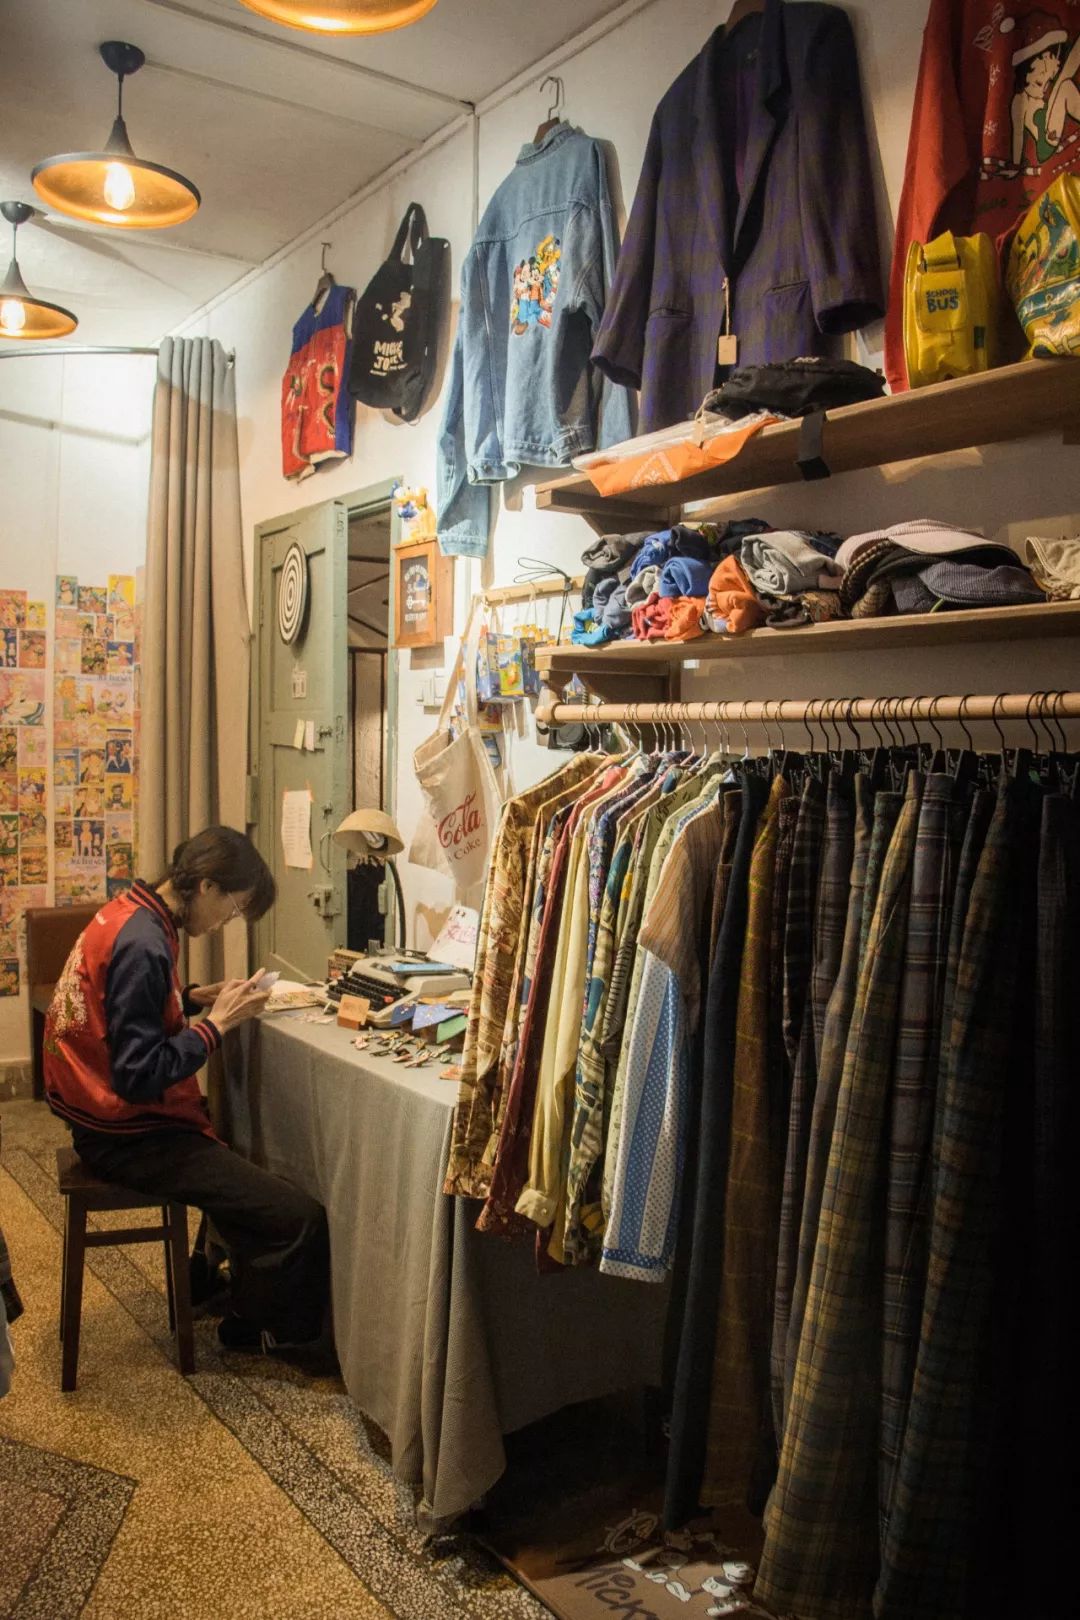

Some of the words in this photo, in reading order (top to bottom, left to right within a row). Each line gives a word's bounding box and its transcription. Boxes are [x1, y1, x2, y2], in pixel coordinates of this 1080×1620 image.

[926, 288, 959, 298] SCHOOL
[927, 296, 959, 313] BUS
[437, 789, 481, 849] Cola
[454, 838, 481, 860] Coke
